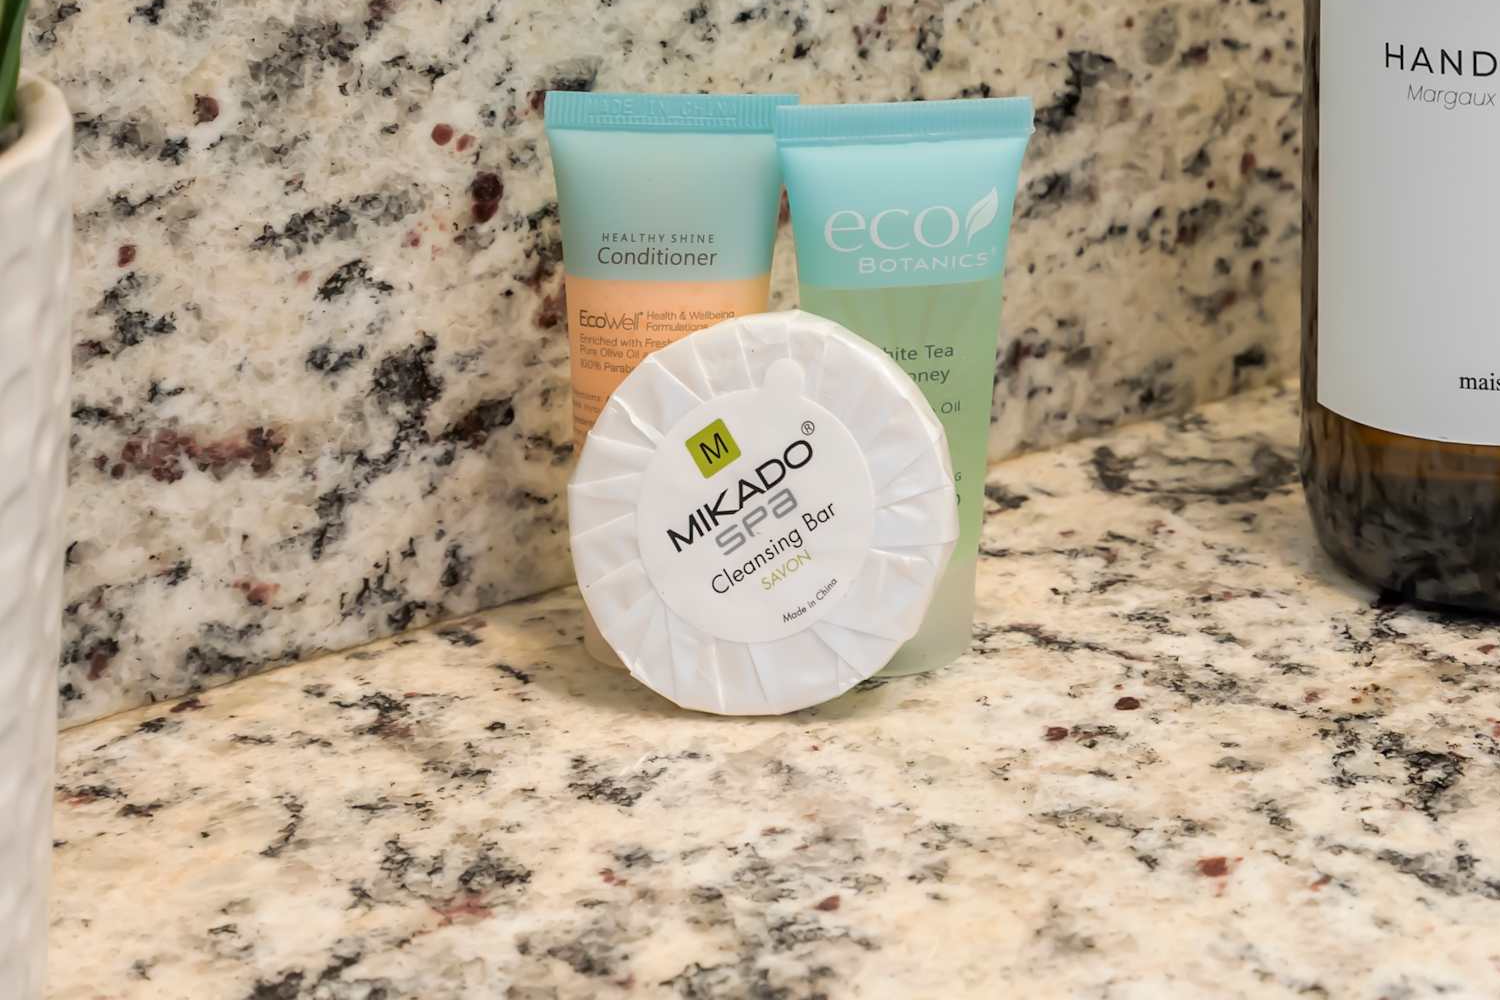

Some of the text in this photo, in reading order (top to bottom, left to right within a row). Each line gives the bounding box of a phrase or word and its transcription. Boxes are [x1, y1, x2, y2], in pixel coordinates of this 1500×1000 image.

[1384, 41, 1498, 77] HAND
[1406, 83, 1497, 110] Margaux
[601, 232, 716, 244] HEALTHY SHINE
[824, 205, 960, 253] eco
[597, 246, 718, 266] Conditioner
[579, 332, 618, 348] Enriched
[620, 336, 643, 348] with
[600, 347, 624, 359] Olive
[924, 344, 954, 360] Tea
[940, 400, 961, 414] Oil
[698, 432, 729, 465] M
[711, 502, 836, 594] Cleansing Bar
[760, 549, 813, 591] SAVON
[782, 577, 838, 623] Made in China
